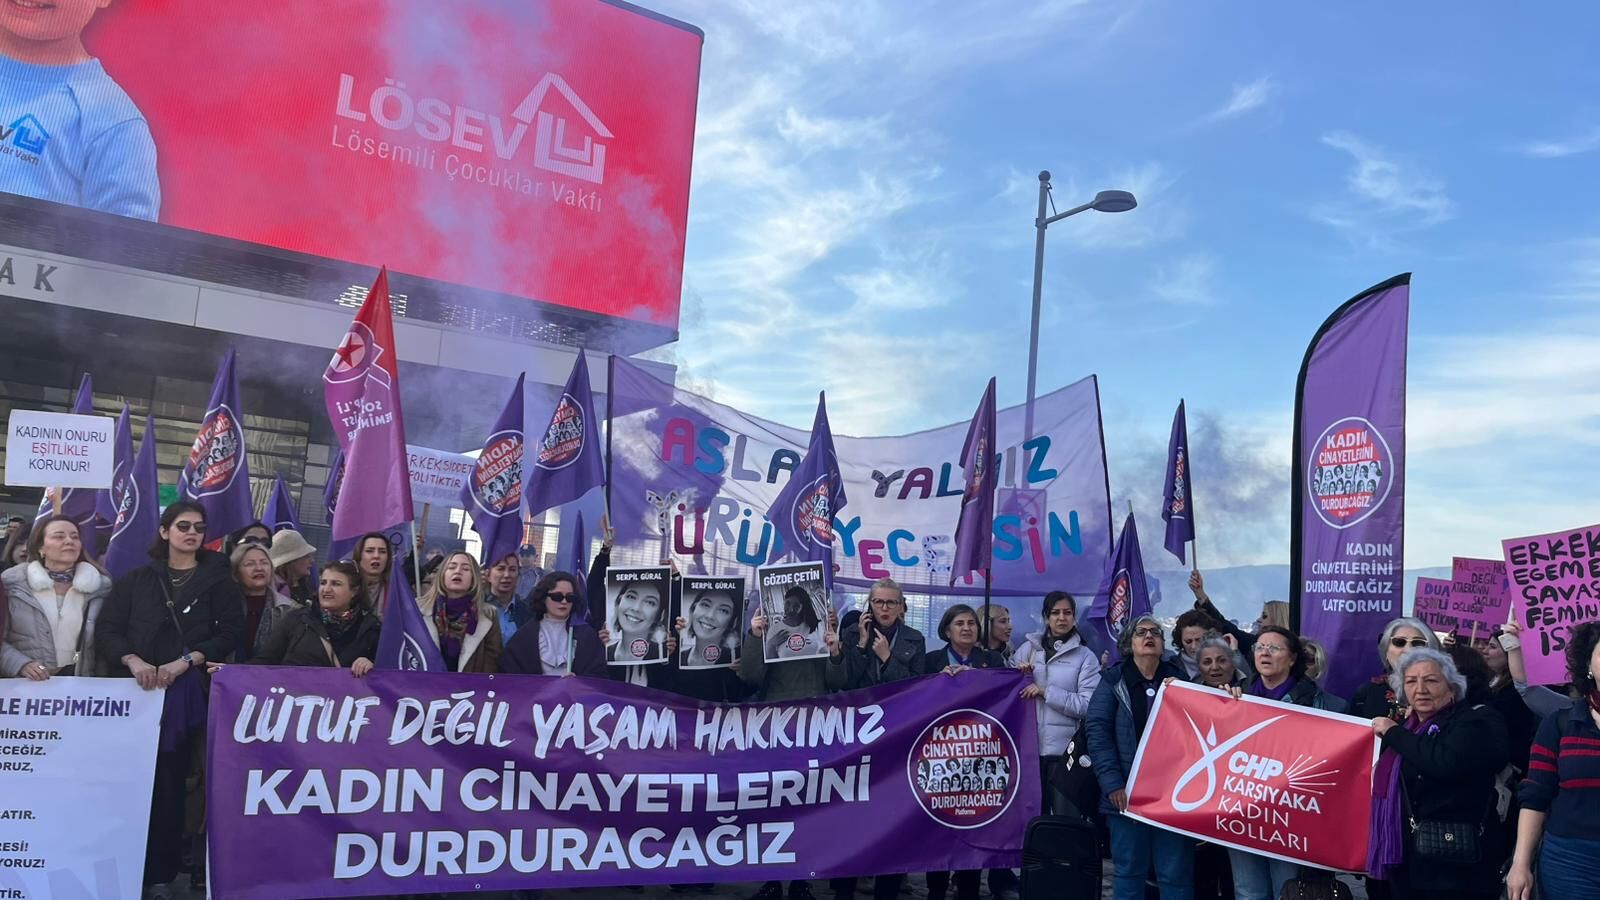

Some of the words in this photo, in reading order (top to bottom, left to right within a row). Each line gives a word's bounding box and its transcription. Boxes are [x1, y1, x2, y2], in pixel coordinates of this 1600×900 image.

[336, 73, 528, 160] LÖSEV
[332, 125, 436, 170] Lösemili
[445, 154, 543, 197] Çocuklar
[551, 181, 602, 212] Vakfı
[16, 425, 62, 439] KADININ
[65, 429, 107, 443] ONURU
[1326, 430, 1368, 449] KADIN
[32, 441, 88, 456] EŞİTLİKLE
[29, 459, 90, 472] KORUNUR!
[661, 417, 800, 483] ASLA
[872, 436, 1057, 500] YALIZ
[1346, 543, 1393, 556] KADIN
[616, 572, 638, 581] SERPİL
[640, 572, 662, 580] GÜRAL
[691, 581, 713, 590] SERPİL
[715, 581, 736, 589] GÜRAL
[763, 573, 793, 586] GÖZDE
[793, 567, 820, 585] ÇETİN
[1322, 599, 1392, 613] LATFORMU
[25, 696, 131, 717] HEPİMİZİN!
[233, 687, 380, 744] LÜTUF
[388, 690, 515, 747] DEĞİL
[532, 702, 677, 760] YAŞAM
[694, 704, 886, 757] HAKKIMIZ
[933, 724, 992, 741] KADIN
[0, 744, 46, 756] CEĞİZ.
[923, 738, 1001, 758] CİNAYETLERİNİ
[0, 762, 33, 773] RUZ,
[1228, 751, 1284, 781] CHP
[244, 768, 443, 815] KADIN
[460, 755, 871, 813] CİNAYETLERİNİ
[1223, 775, 1321, 814] KARŞIYAKA
[931, 791, 1002, 809] DURDURACAĞIZ
[0, 810, 36, 820] ATIR.
[1218, 795, 1289, 828] KADIN
[1216, 815, 1307, 852] KOLLARI
[0, 840, 28, 852] ESİ!
[333, 815, 796, 879] DURDURACAĞIZ
